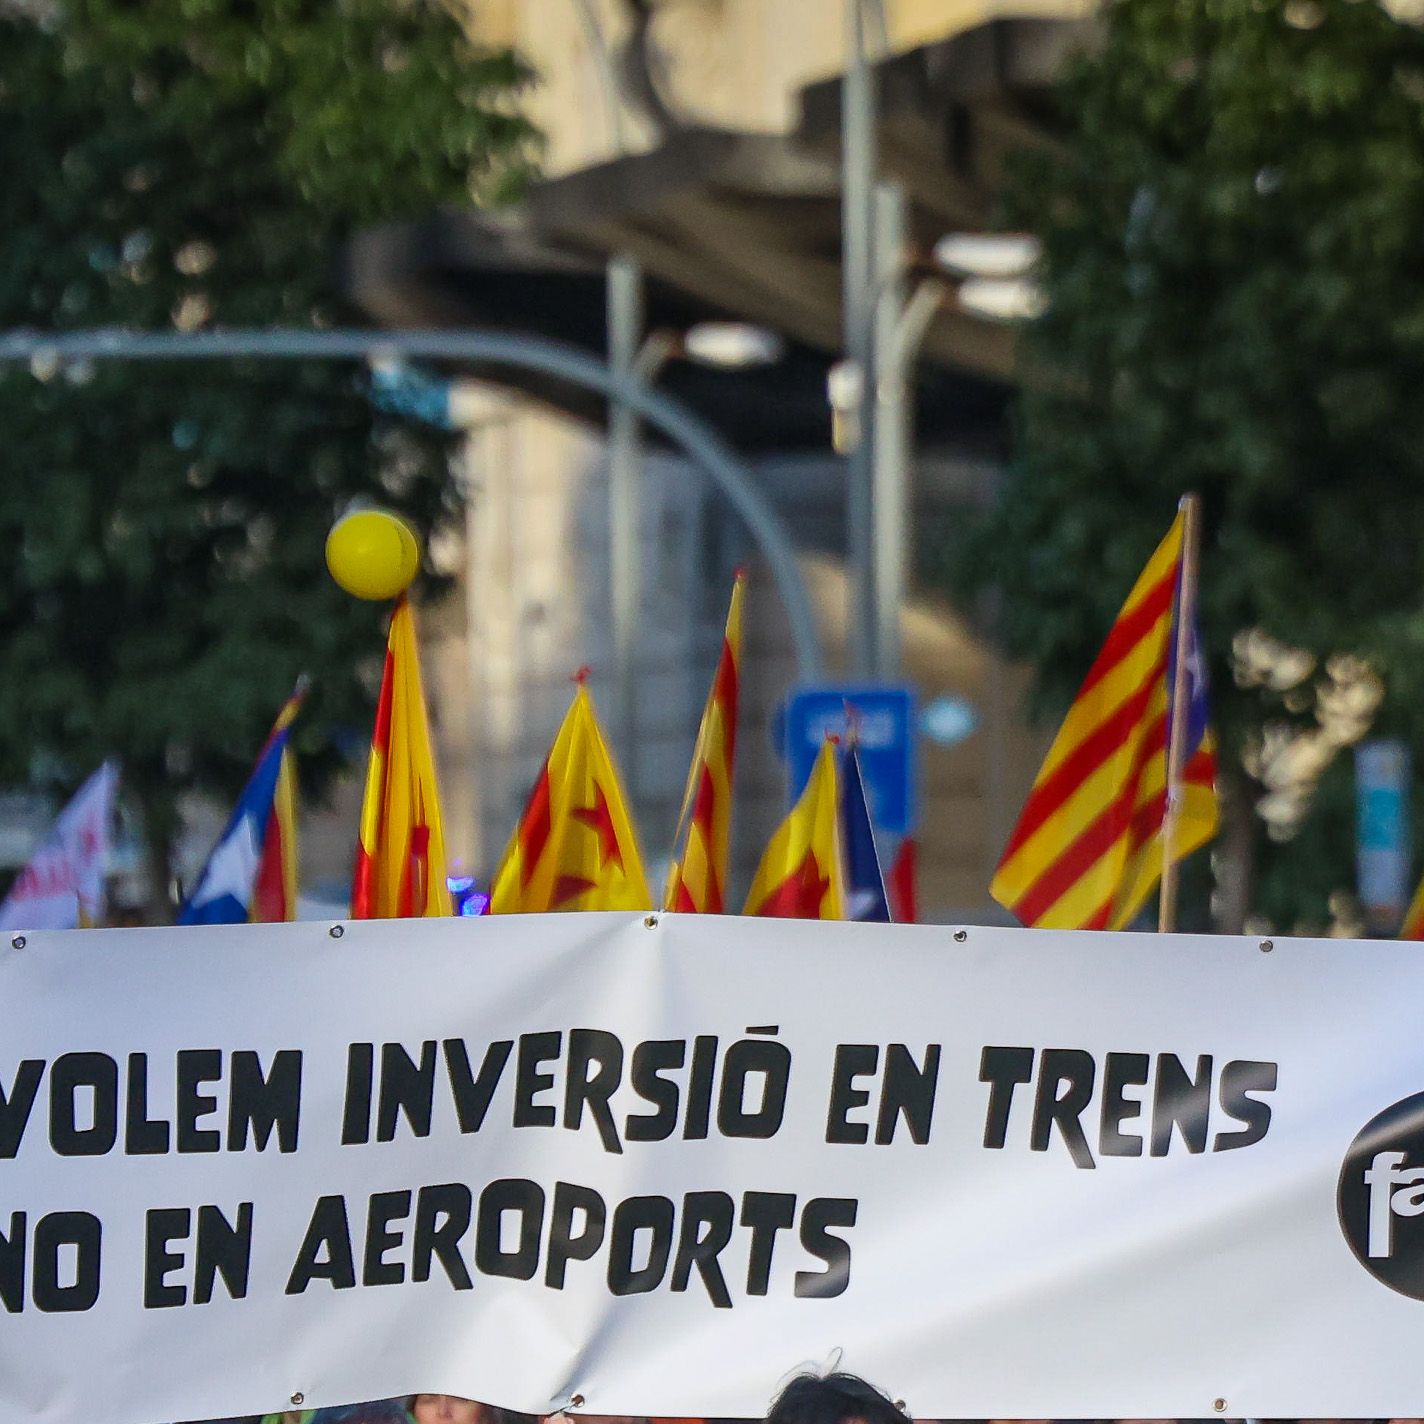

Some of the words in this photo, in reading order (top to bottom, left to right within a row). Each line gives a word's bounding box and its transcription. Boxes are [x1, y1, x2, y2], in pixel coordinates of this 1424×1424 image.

[341, 1025, 792, 1155] INVERSIÓ
[825, 1043, 942, 1146] EN
[977, 1045, 1278, 1170] TRENS
[144, 1202, 254, 1309] EN
[284, 1177, 858, 1309] AEROPORTS
